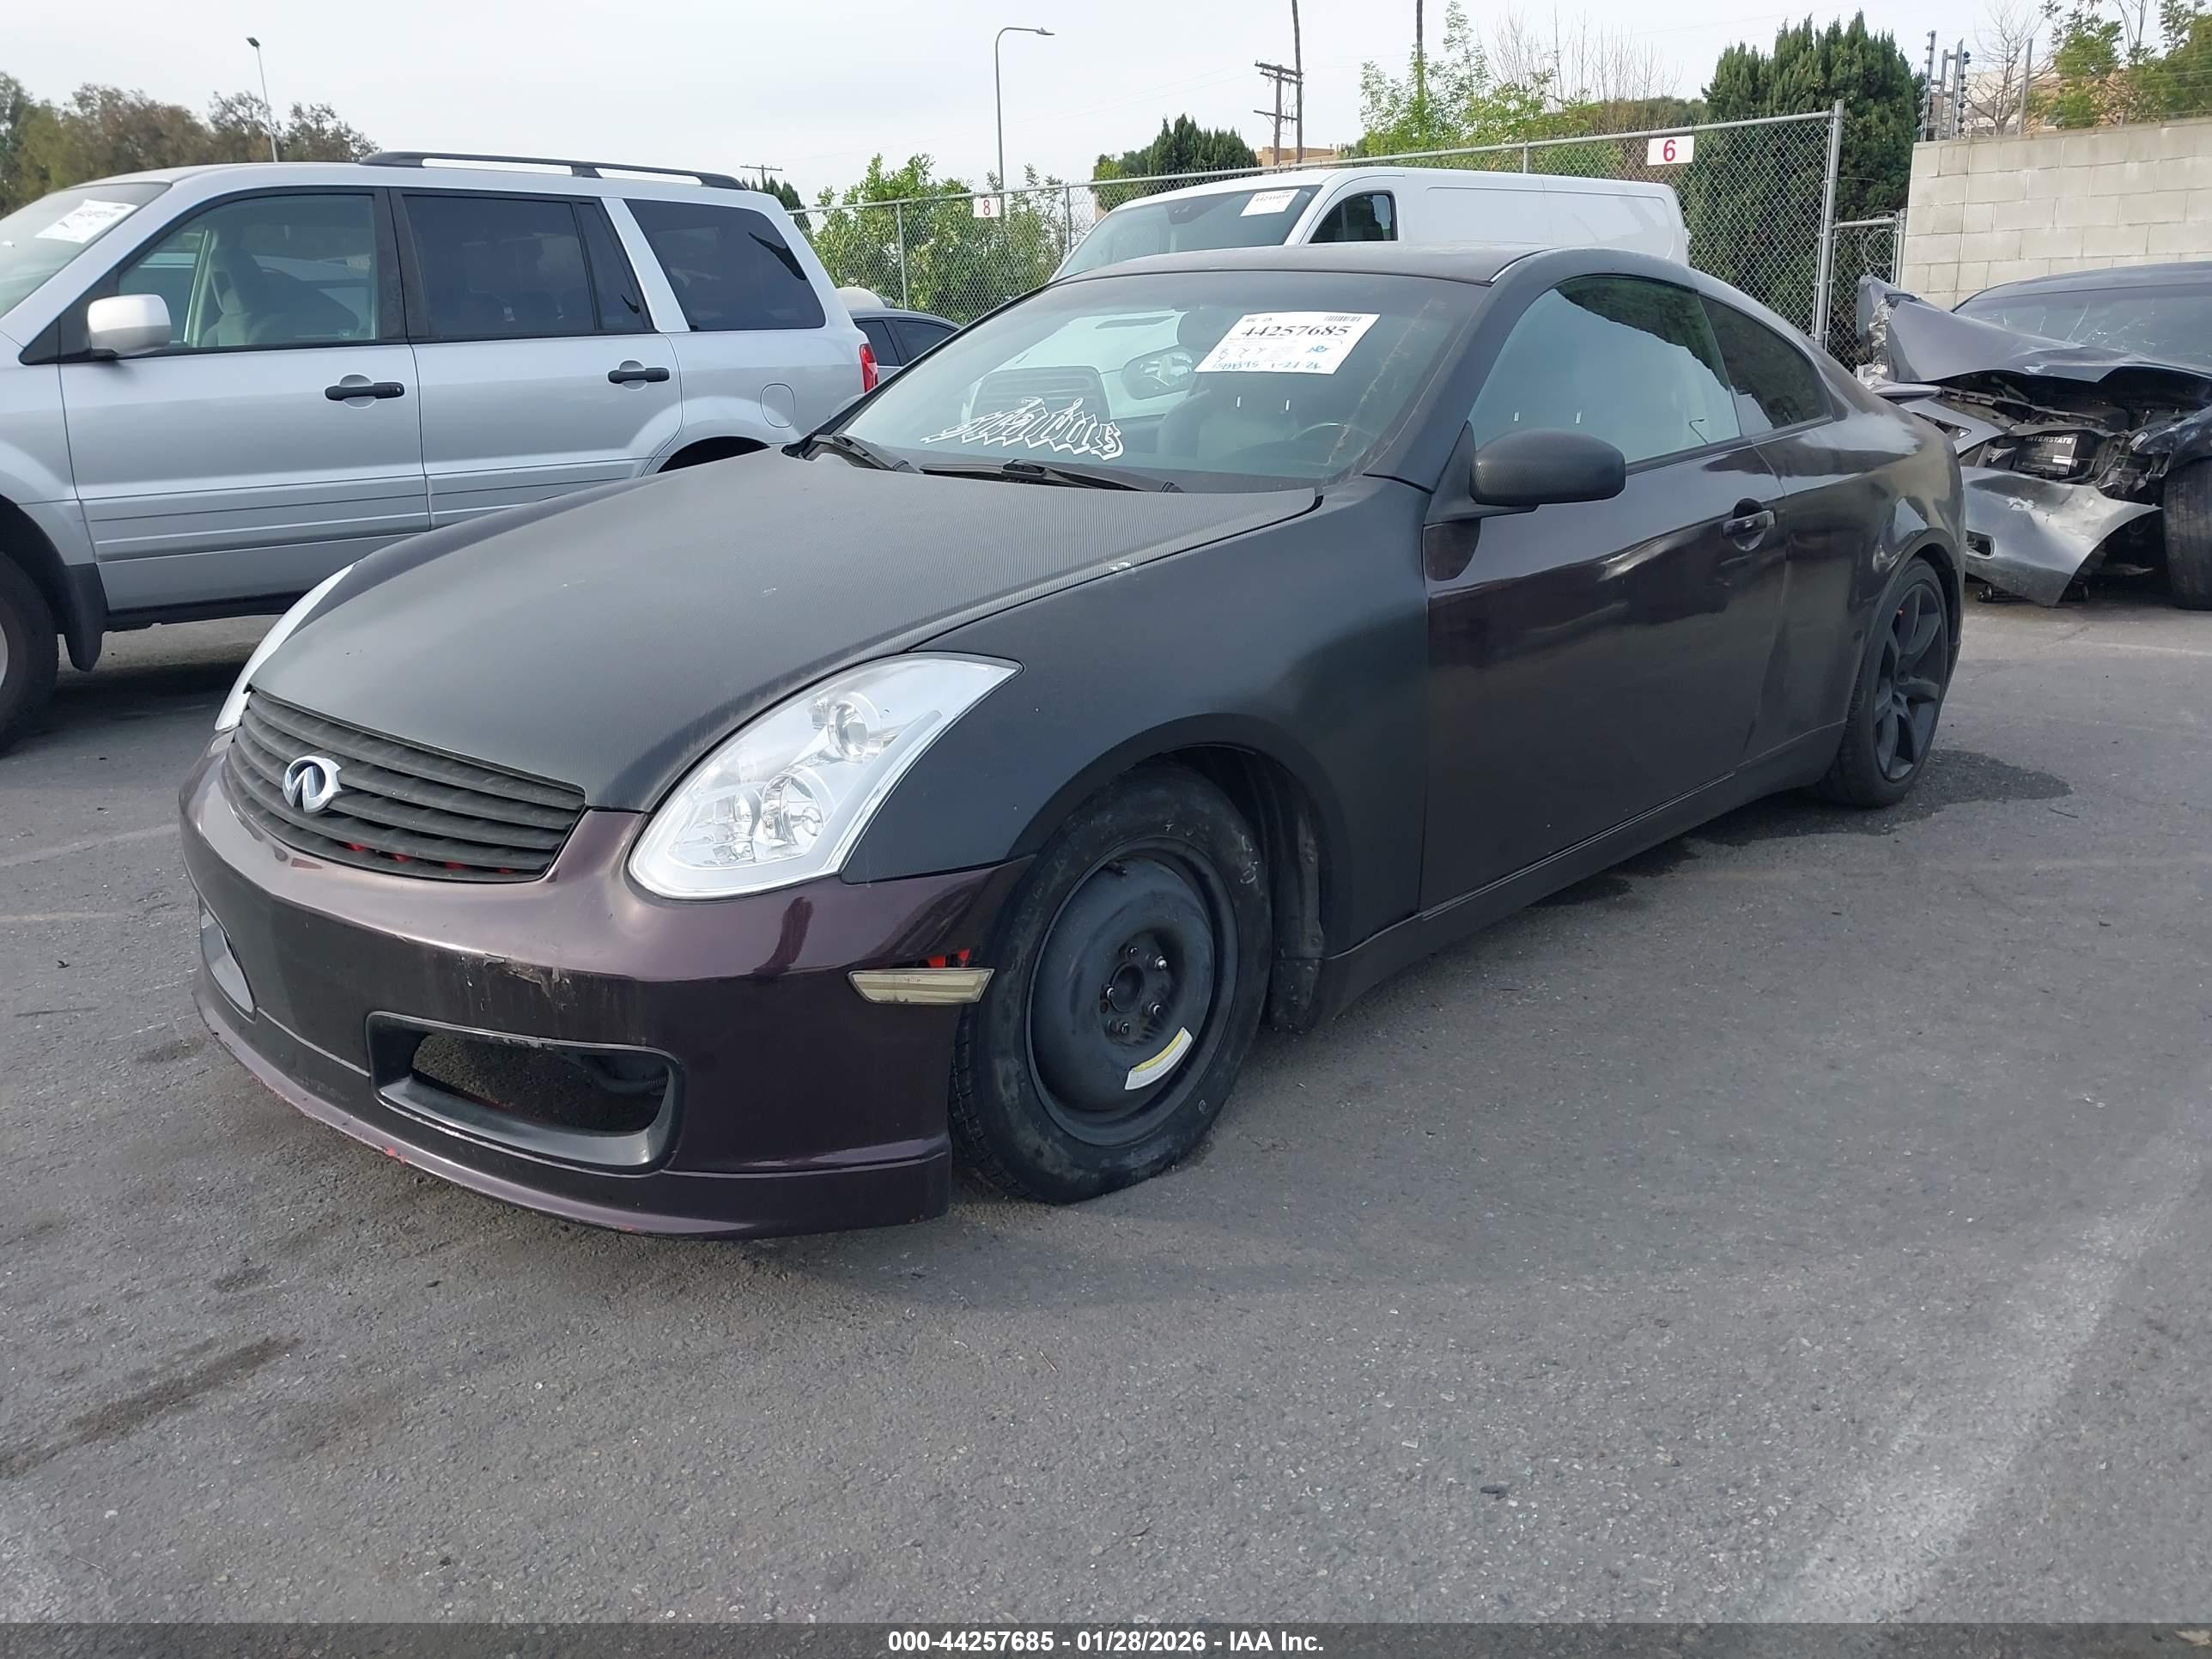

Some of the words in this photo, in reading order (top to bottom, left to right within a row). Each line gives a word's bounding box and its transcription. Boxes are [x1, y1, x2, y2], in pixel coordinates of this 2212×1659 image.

[1663, 138, 1676, 162] 6
[983, 199, 991, 216] 8
[1242, 325, 1353, 337] 44257685
[2025, 435, 2074, 444] INTERSTATE
